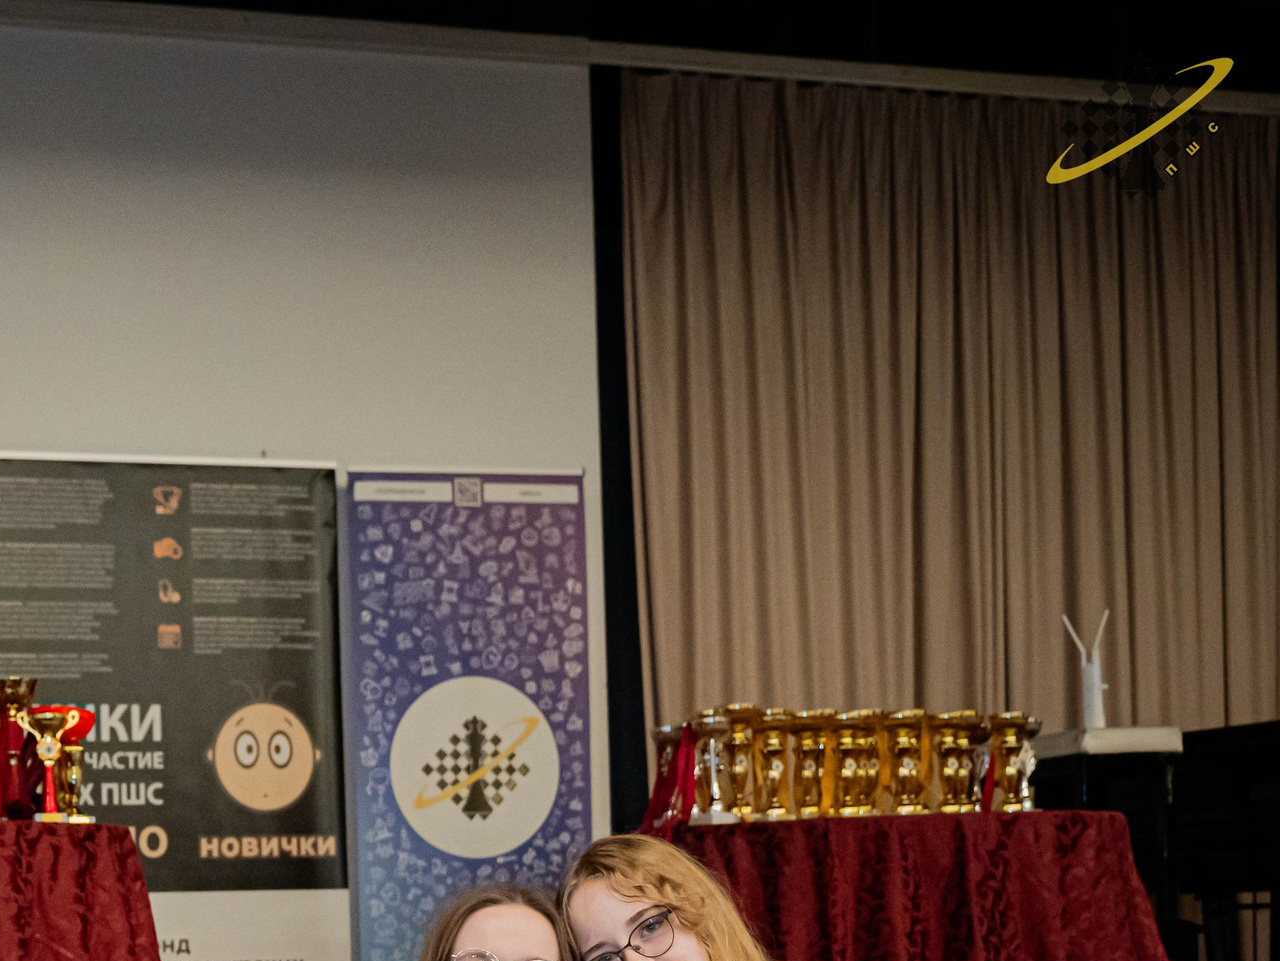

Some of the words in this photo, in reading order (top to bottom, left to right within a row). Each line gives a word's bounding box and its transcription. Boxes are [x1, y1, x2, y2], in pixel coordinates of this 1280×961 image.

[84, 751, 165, 770] ЧАСТИЕ
[101, 782, 164, 806] ПШС
[200, 836, 336, 858] НОВИЧКИ
[162, 939, 191, 955] НД
